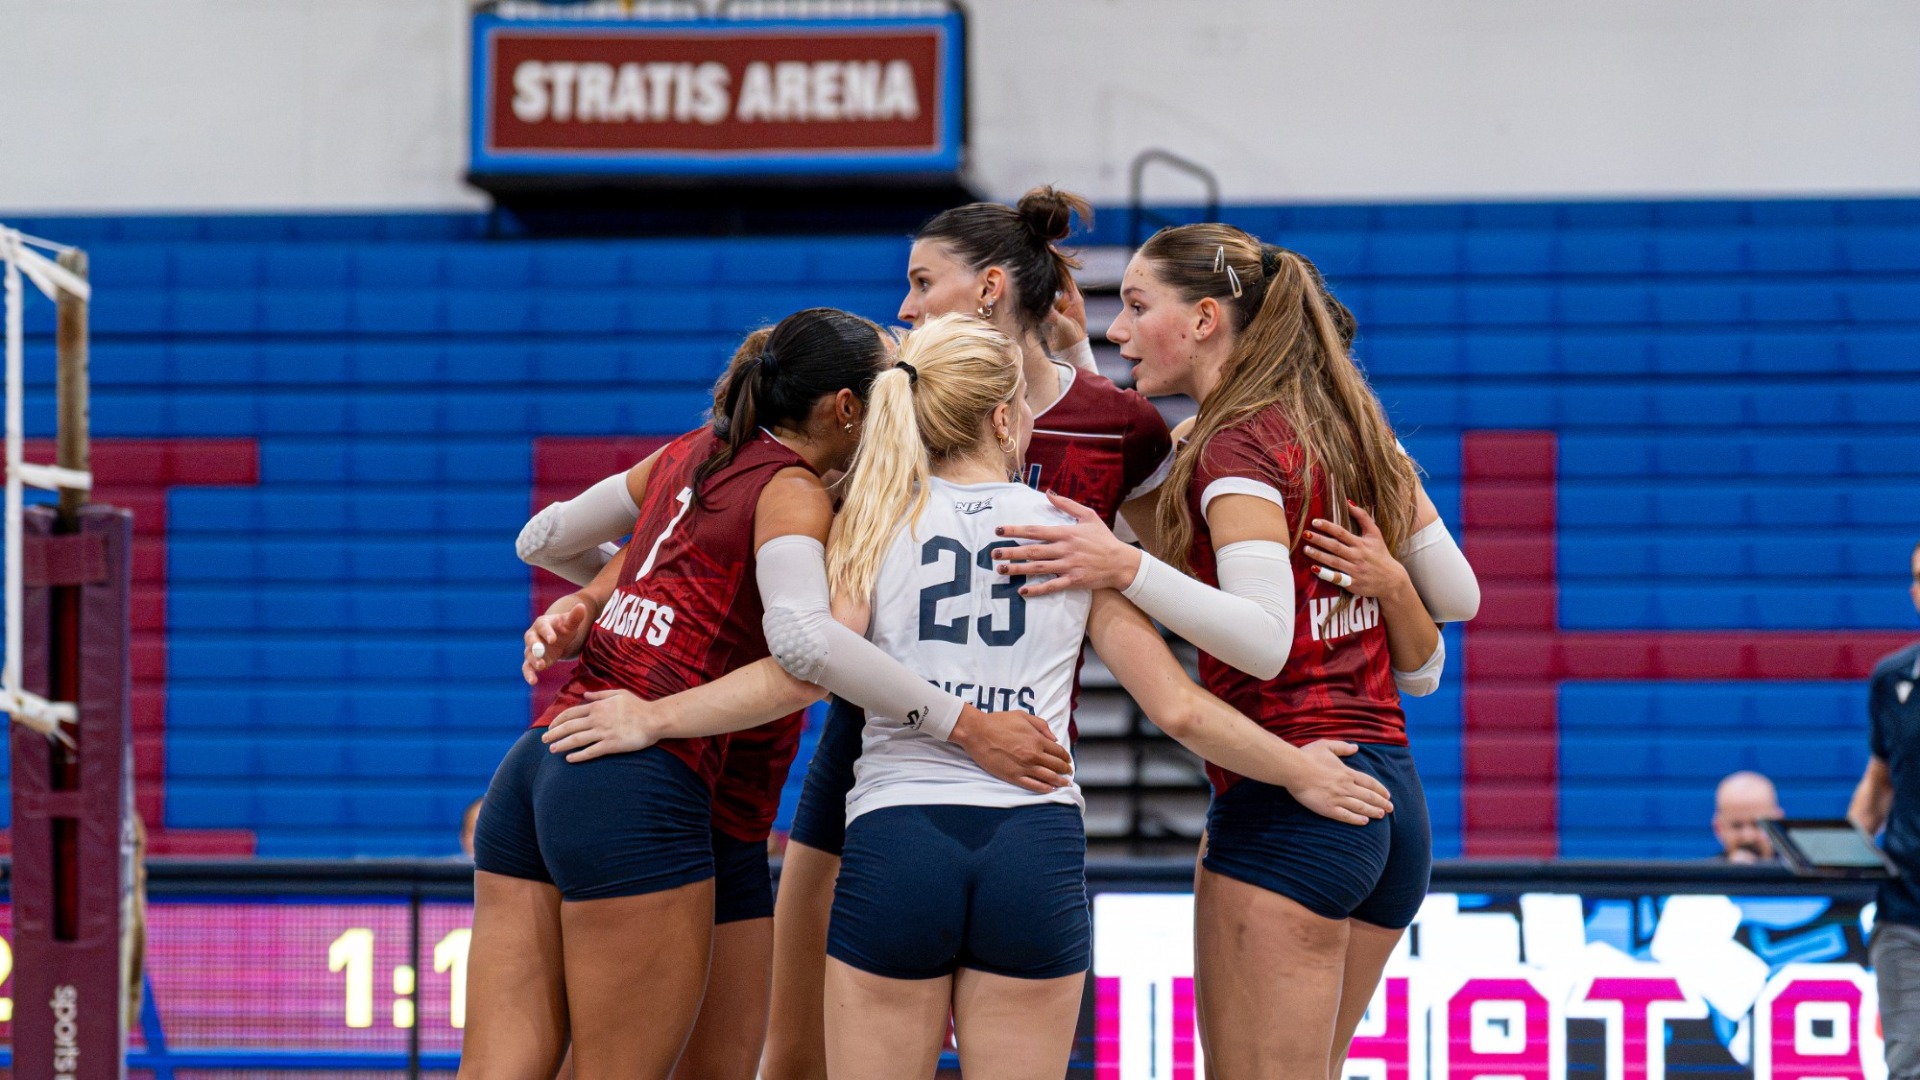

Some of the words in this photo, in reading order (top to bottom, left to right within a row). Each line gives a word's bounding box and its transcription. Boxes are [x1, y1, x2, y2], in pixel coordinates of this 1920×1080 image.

[511, 60, 731, 124] STRATIS
[736, 60, 921, 121] ARENA
[595, 588, 676, 647] NIGHTS
[918, 535, 1027, 647] 23
